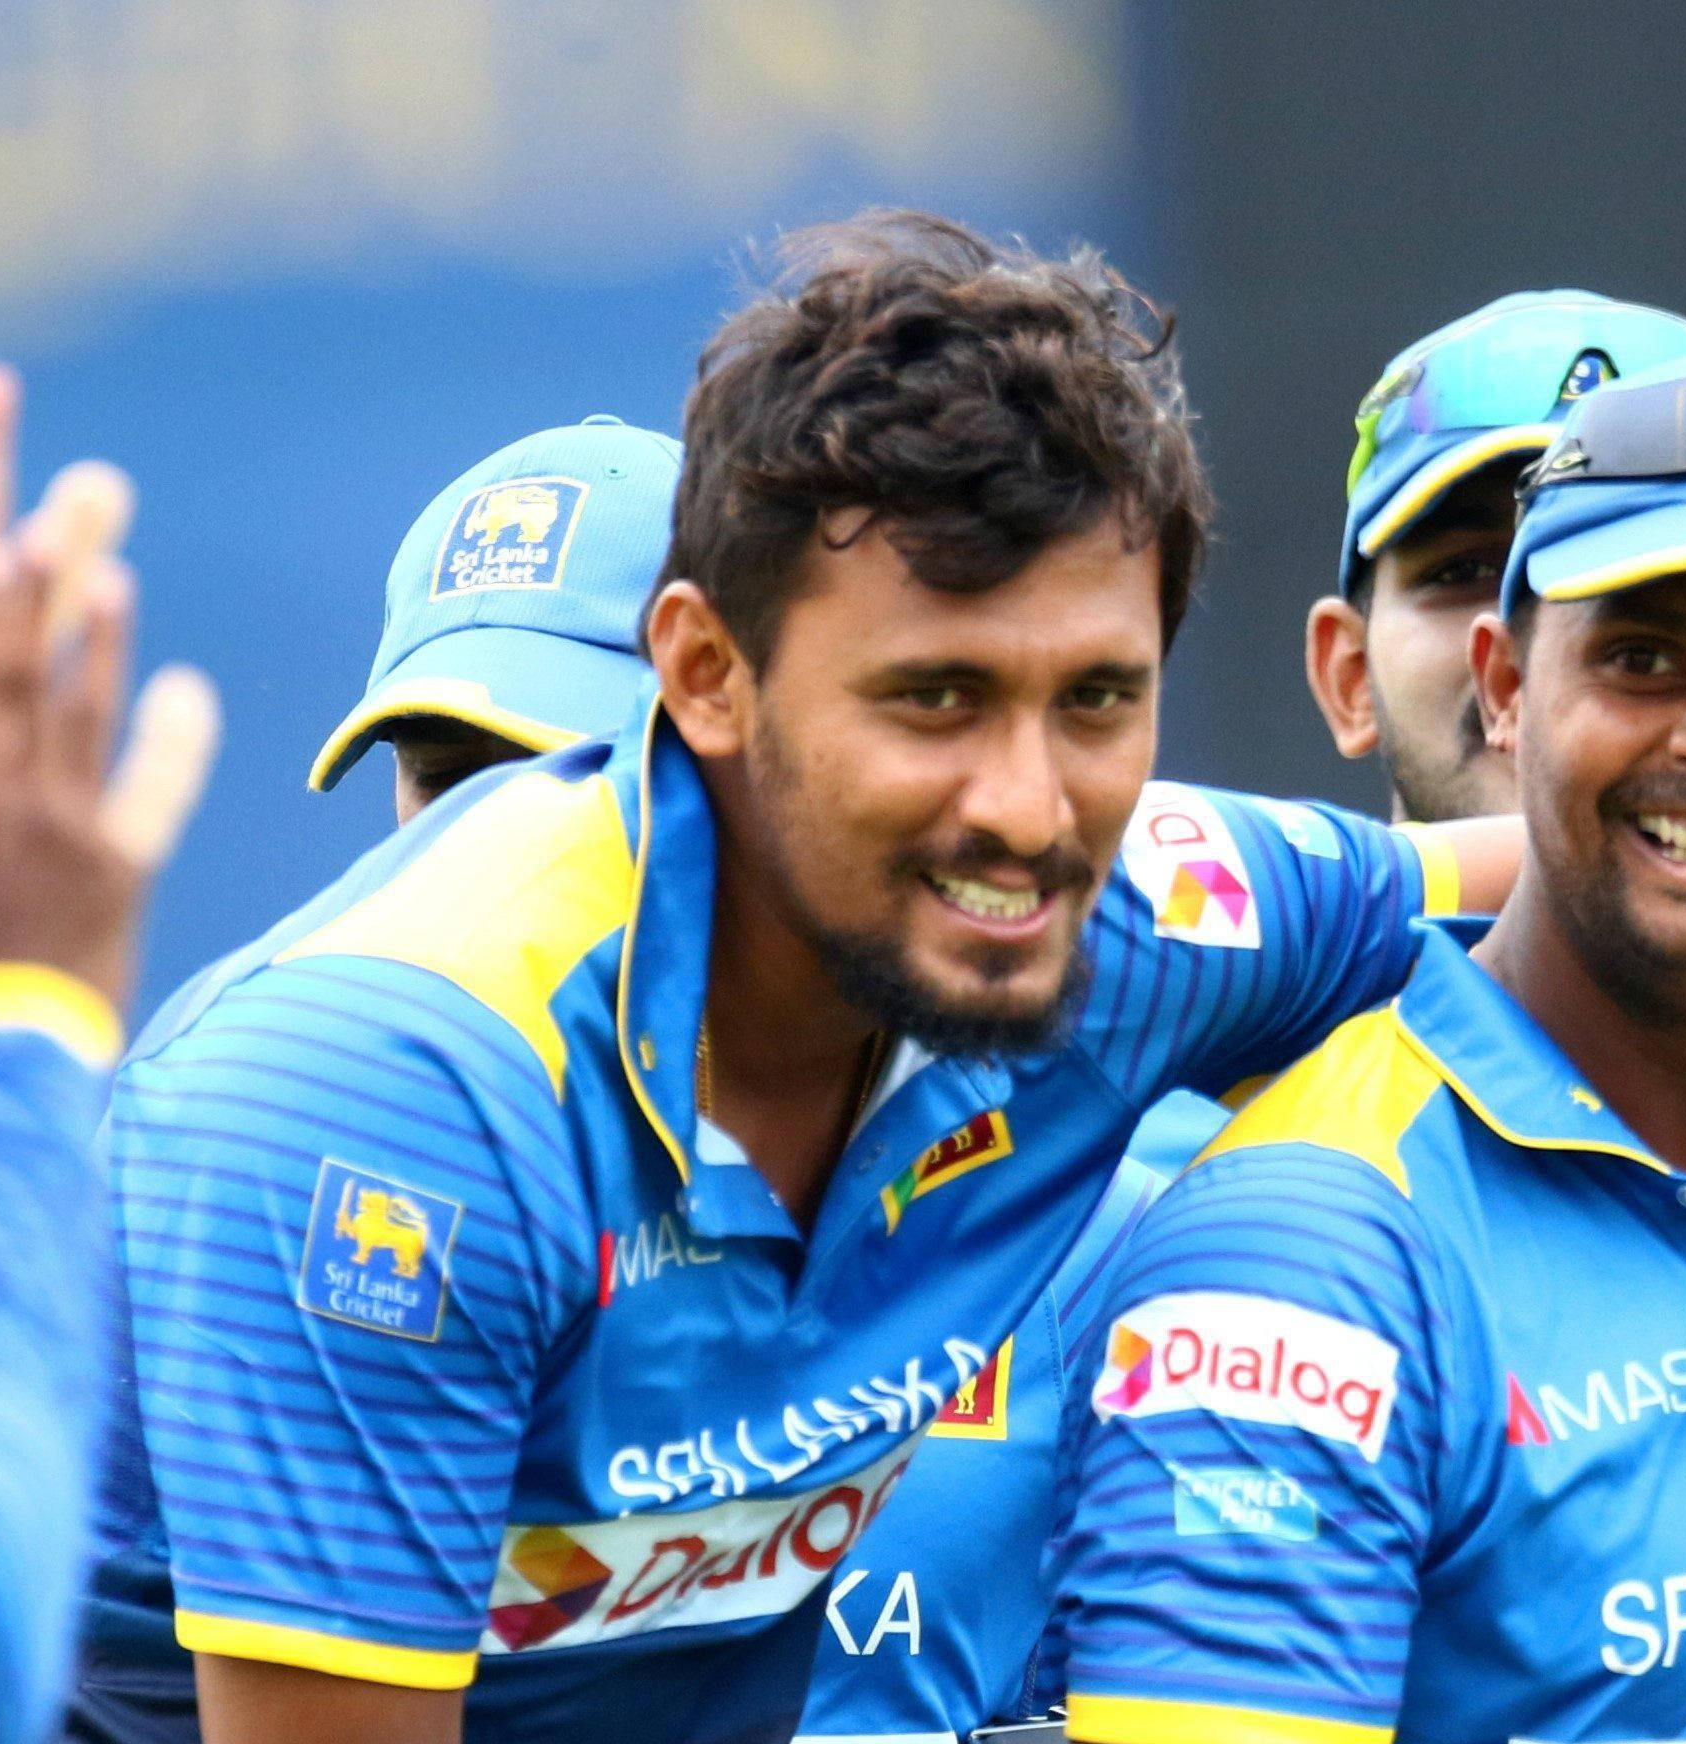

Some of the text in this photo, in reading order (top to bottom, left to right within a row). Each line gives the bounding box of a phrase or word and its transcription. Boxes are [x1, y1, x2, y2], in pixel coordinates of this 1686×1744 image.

[450, 542, 549, 574] Sri Lanka
[455, 562, 536, 590] Cricket
[323, 1262, 420, 1308] Sri Lanka
[329, 1288, 405, 1327] Cricket
[1163, 1327, 1382, 1441] Dialog
